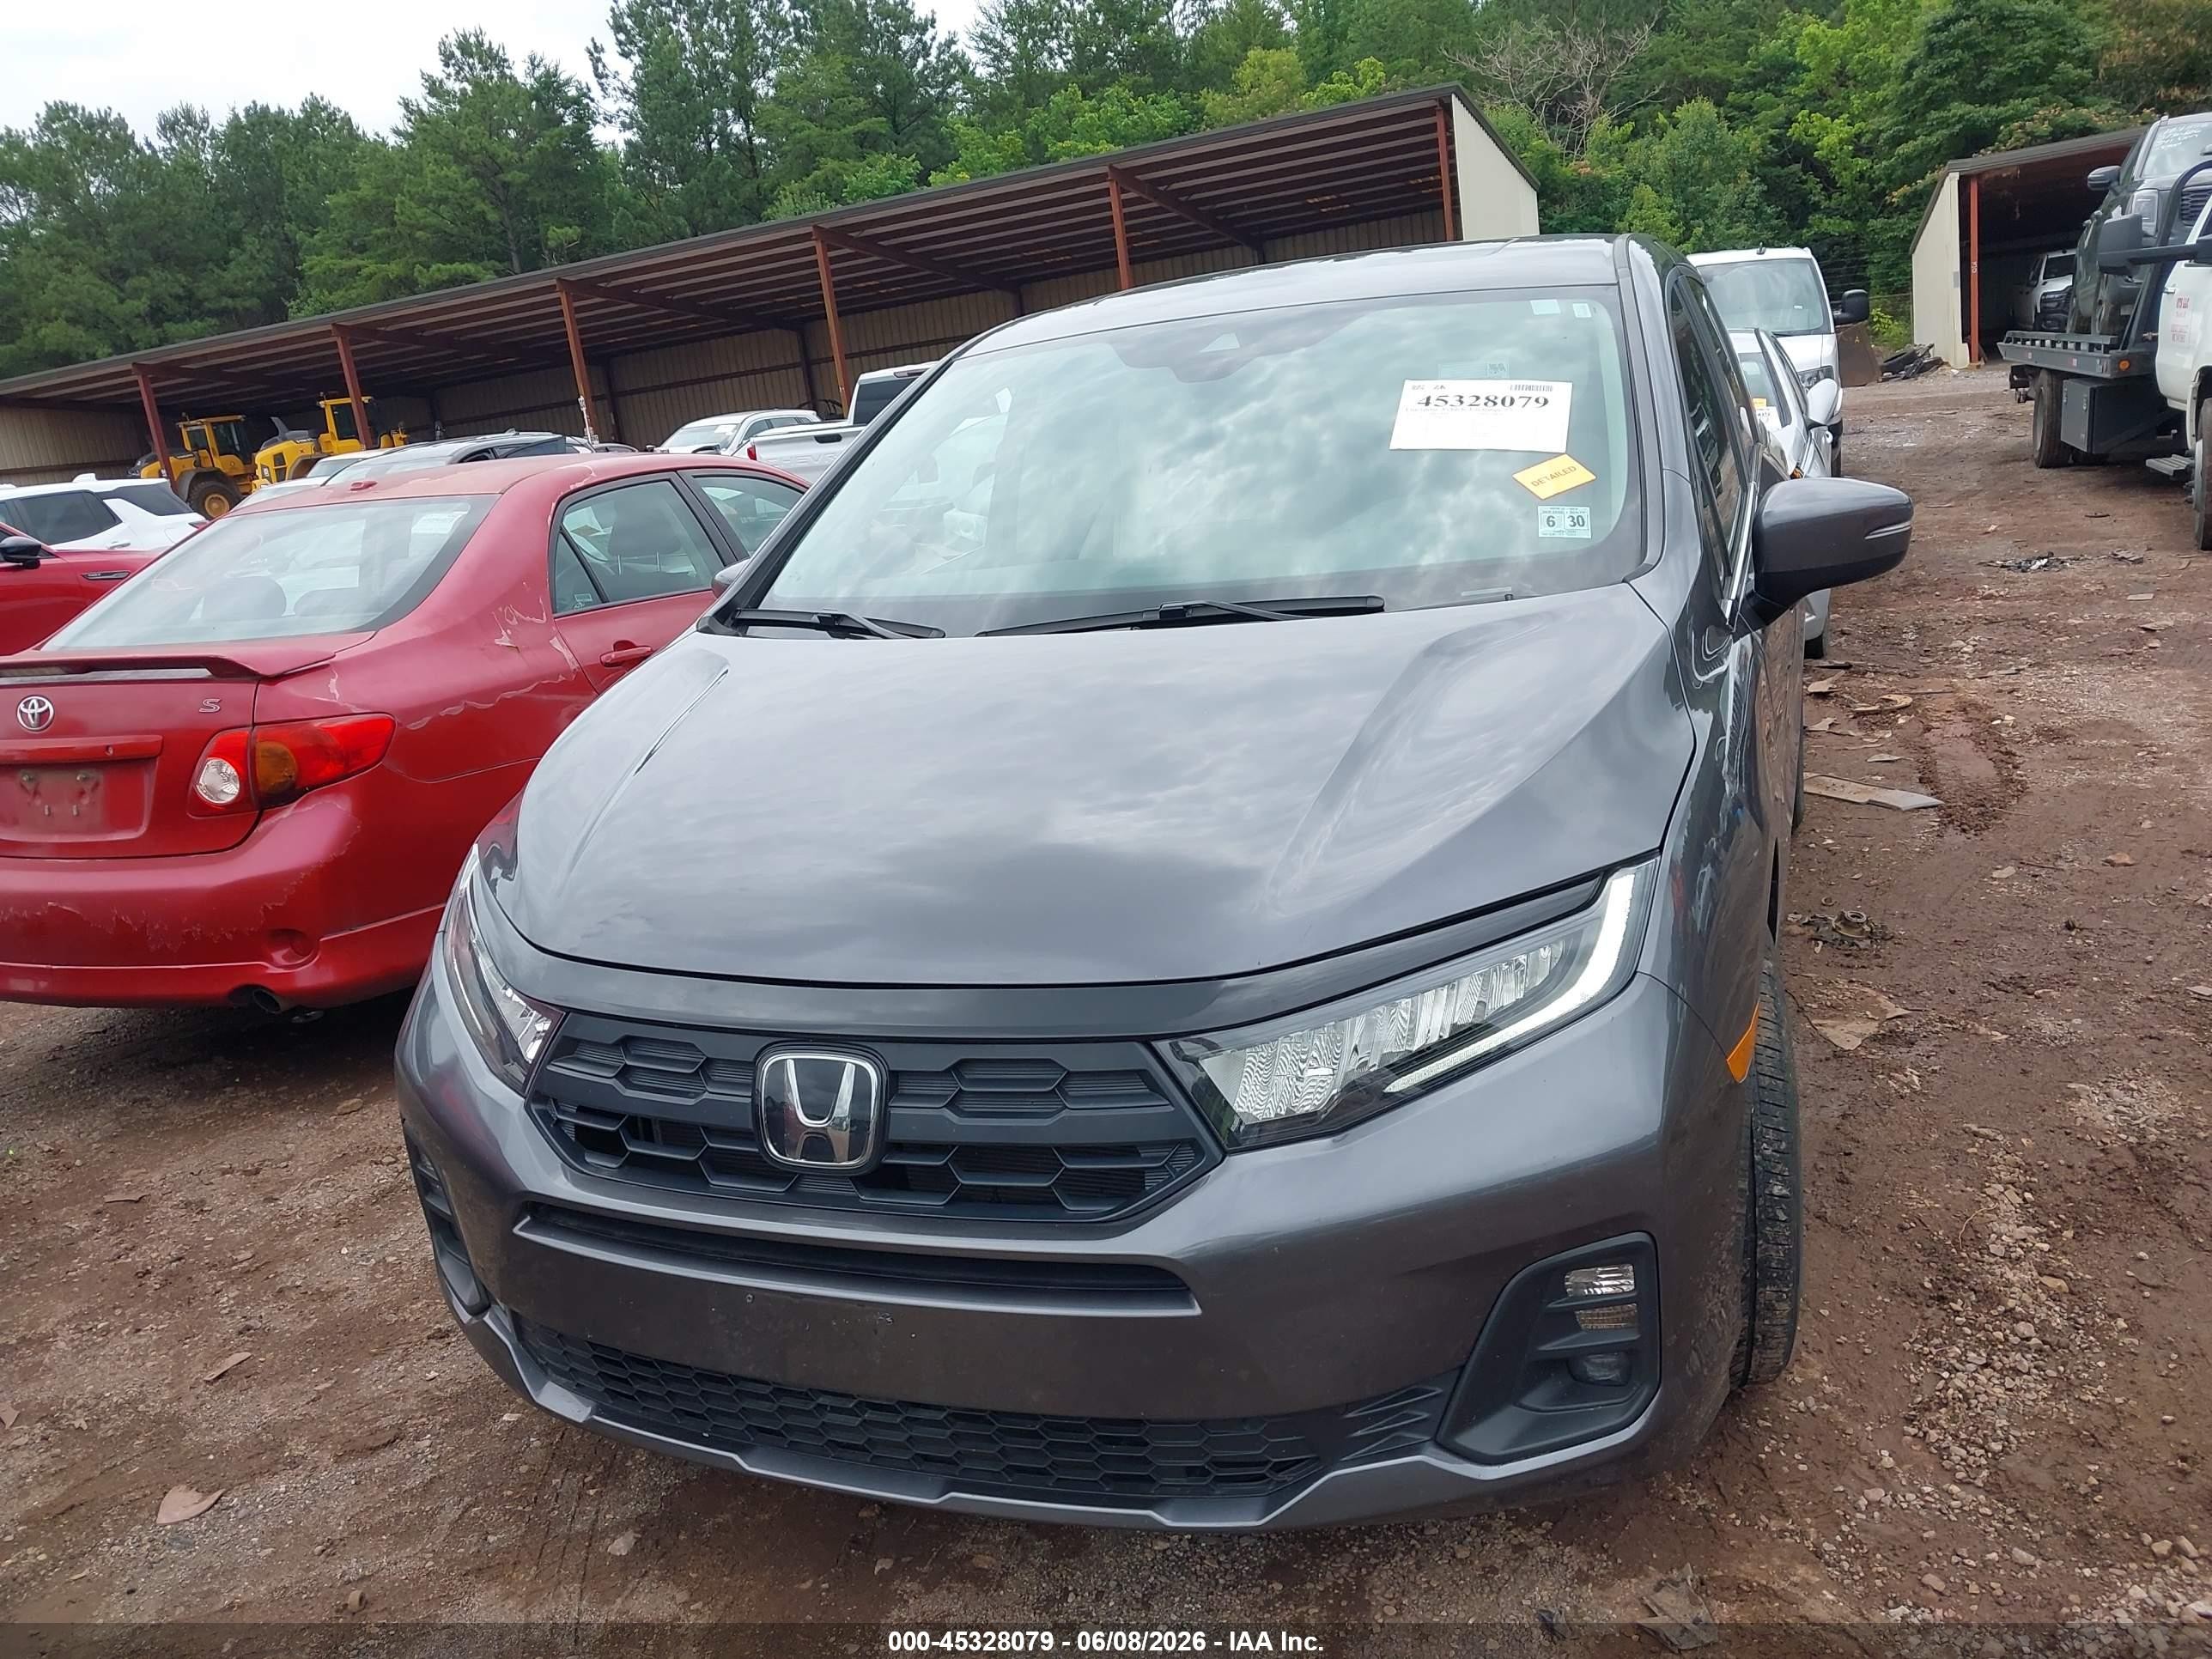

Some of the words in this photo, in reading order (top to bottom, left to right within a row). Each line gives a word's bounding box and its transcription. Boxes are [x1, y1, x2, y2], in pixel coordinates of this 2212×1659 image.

[1416, 394, 1550, 409] 45328079
[1530, 465, 1577, 487] DETAILED
[1546, 514, 1556, 528] 6
[1566, 515, 1585, 528] 30
[198, 698, 221, 713] S
